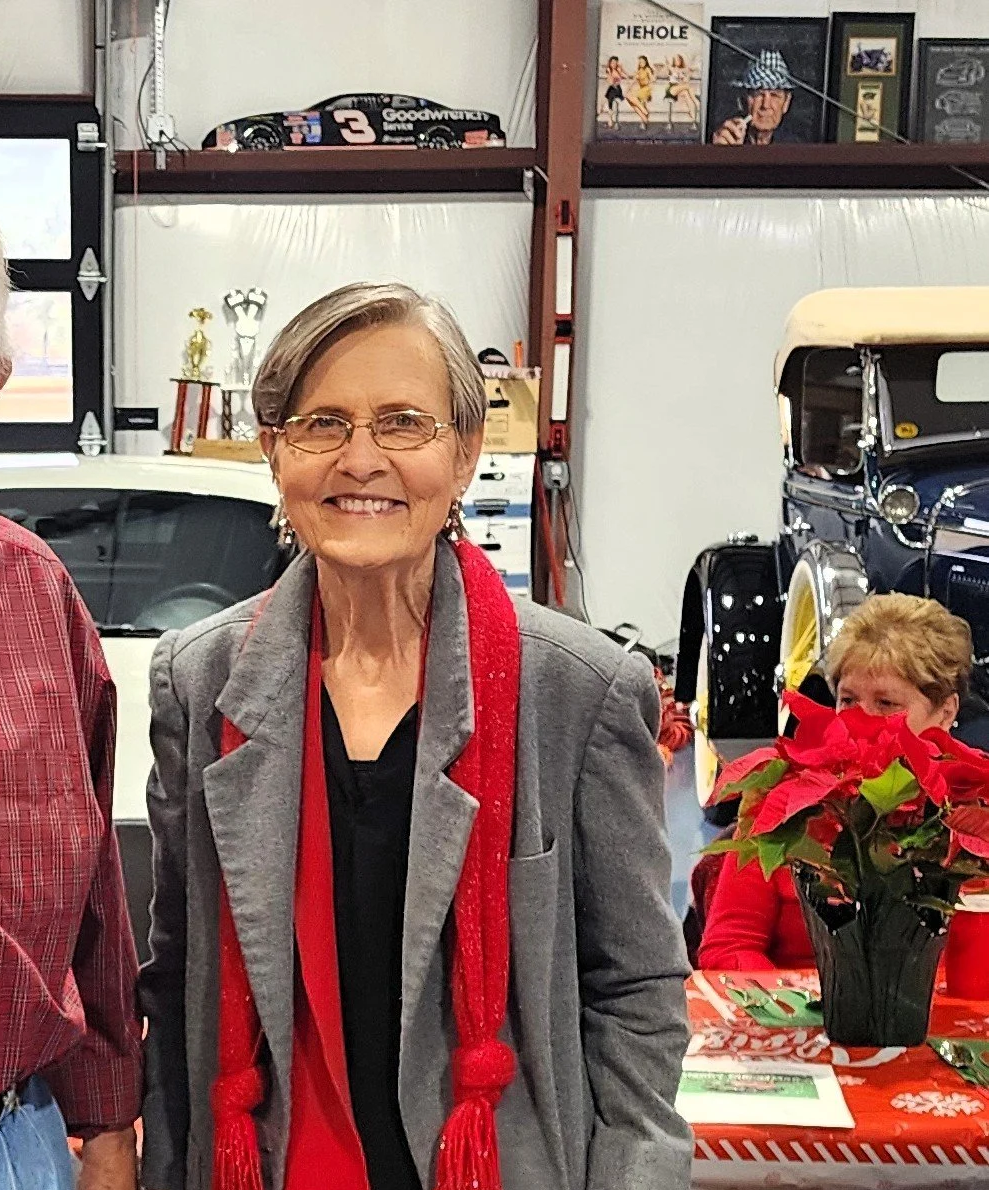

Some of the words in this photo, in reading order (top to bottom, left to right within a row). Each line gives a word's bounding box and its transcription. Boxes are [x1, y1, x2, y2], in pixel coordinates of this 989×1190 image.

[616, 25, 689, 40] PIEHOLE
[382, 107, 491, 121] Goodwrench
[333, 109, 377, 143] 3
